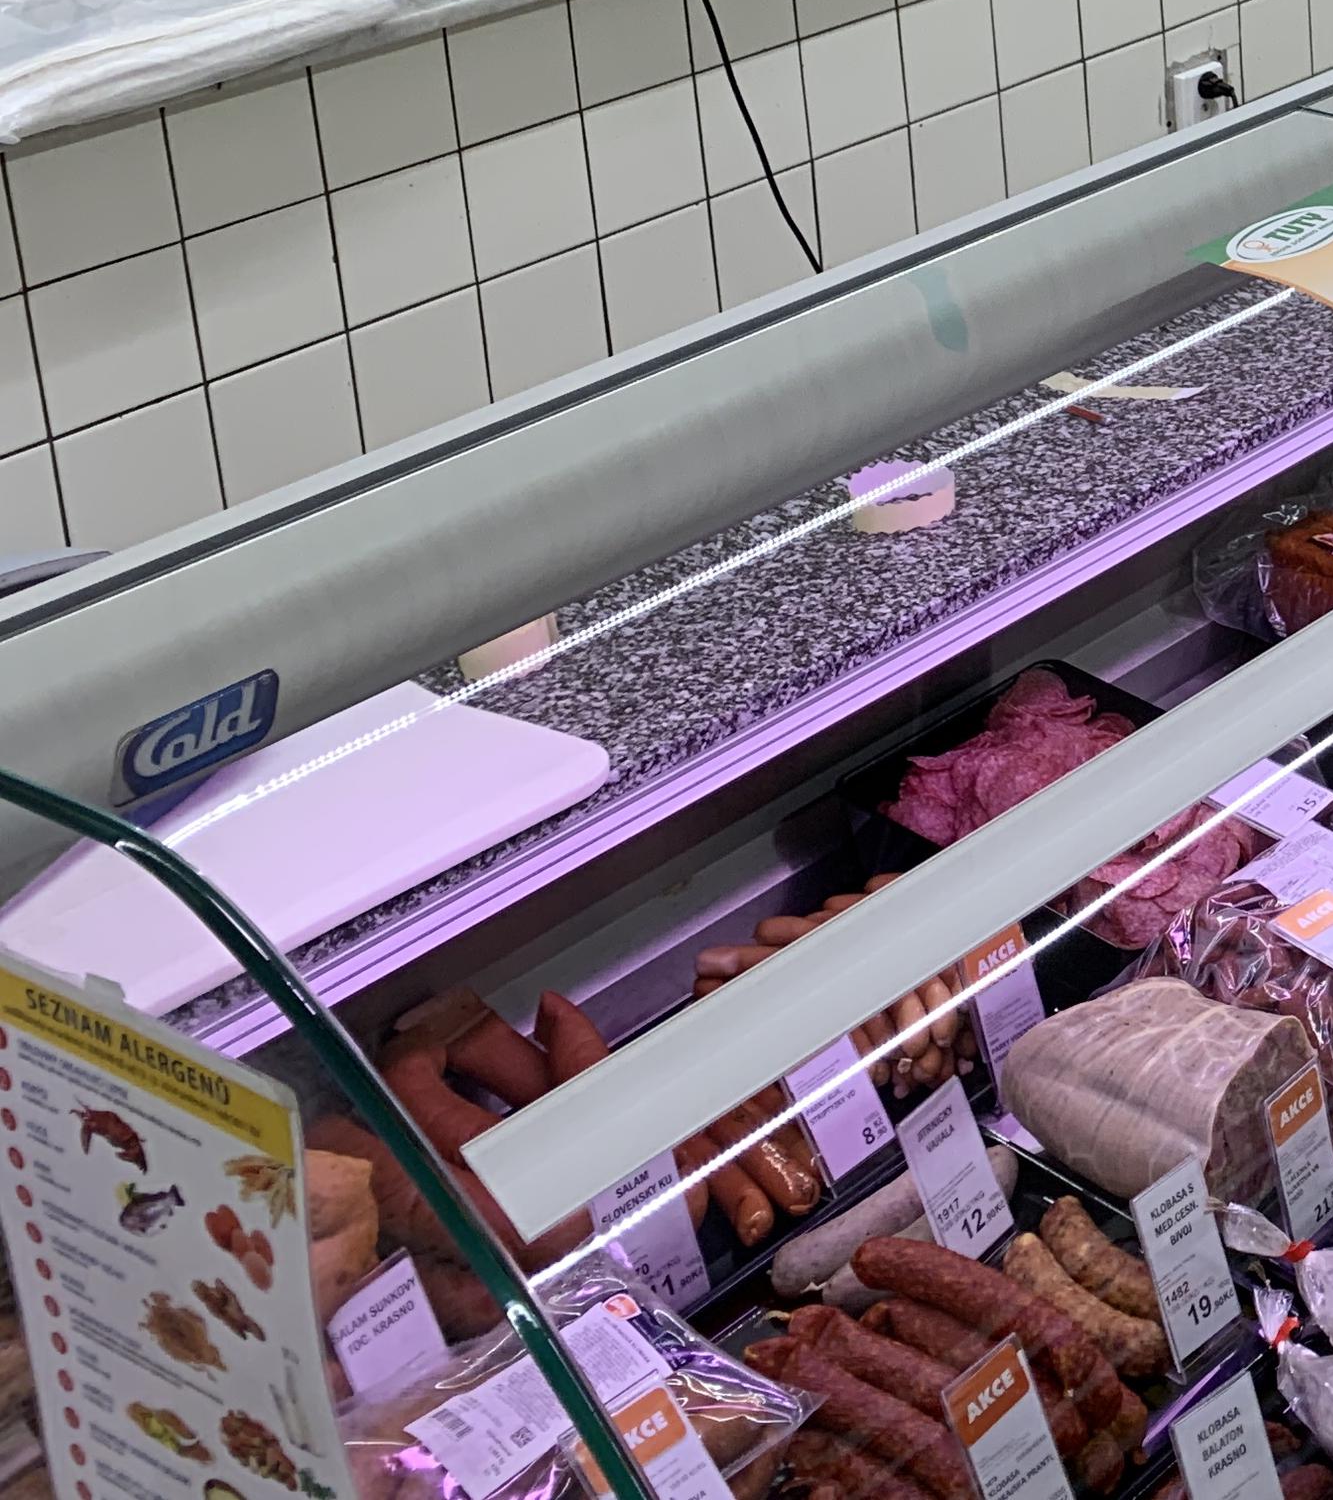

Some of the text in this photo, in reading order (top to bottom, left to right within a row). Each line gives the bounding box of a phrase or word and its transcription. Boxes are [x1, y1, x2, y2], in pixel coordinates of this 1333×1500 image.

[1264, 211, 1328, 241] TUTY
[134, 681, 262, 778] Cold
[1296, 796, 1319, 816] 15
[978, 937, 1018, 978] AKCE
[26, 988, 113, 1046] SEZNAM
[120, 1034, 231, 1105] ALERGENŮ
[1280, 1087, 1314, 1128] AKCE
[862, 1126, 876, 1145] 8
[601, 1174, 673, 1224] SLOVENSKY KU
[616, 1170, 649, 1199] SALAM
[1151, 1183, 1194, 1221] KLOBASA S
[961, 1209, 986, 1239] 12
[1314, 1197, 1331, 1223] 21
[1170, 1222, 1193, 1246] BIVOJ
[369, 1276, 416, 1318] SUNKOVY
[1164, 1281, 1190, 1307] 1482
[1188, 1295, 1212, 1326] 19
[372, 1300, 416, 1337] KRASNO
[966, 1368, 1016, 1425] AKCE
[622, 1410, 669, 1450] KCE
[1196, 1406, 1241, 1444] KLOBASA
[1202, 1425, 1245, 1462] BALATON
[1208, 1443, 1248, 1479] KRASNO
